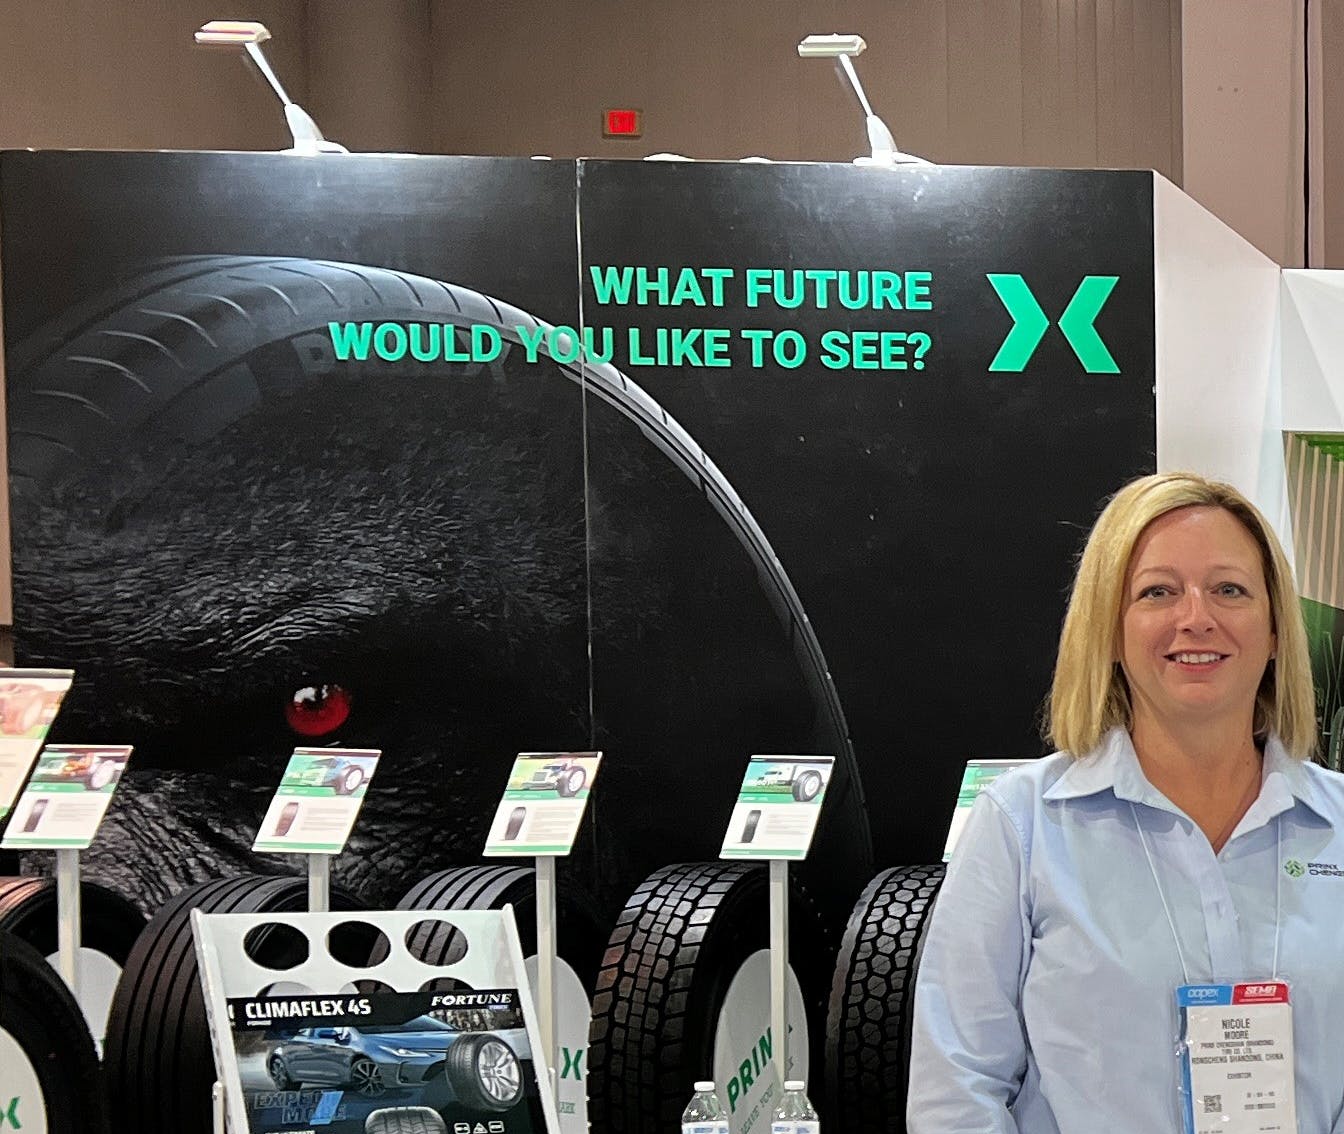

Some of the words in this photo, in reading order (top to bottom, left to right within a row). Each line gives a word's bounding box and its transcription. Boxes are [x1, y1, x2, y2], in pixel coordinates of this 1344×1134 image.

[590, 266, 734, 306] WHAT
[746, 269, 933, 310] FUTURE
[328, 321, 502, 364] WOULD
[515, 325, 614, 365] YOU
[628, 327, 732, 368] LIKE
[742, 329, 807, 370] TO
[820, 330, 933, 371] SEE?
[245, 1000, 345, 1019] CLIMAFLEX
[348, 999, 372, 1016] 4S
[431, 993, 512, 1007] FORTUNE
[1221, 1018, 1250, 1030] NICOLE
[1224, 1030, 1249, 1040] MOORE
[727, 1025, 773, 1114] PRIN
